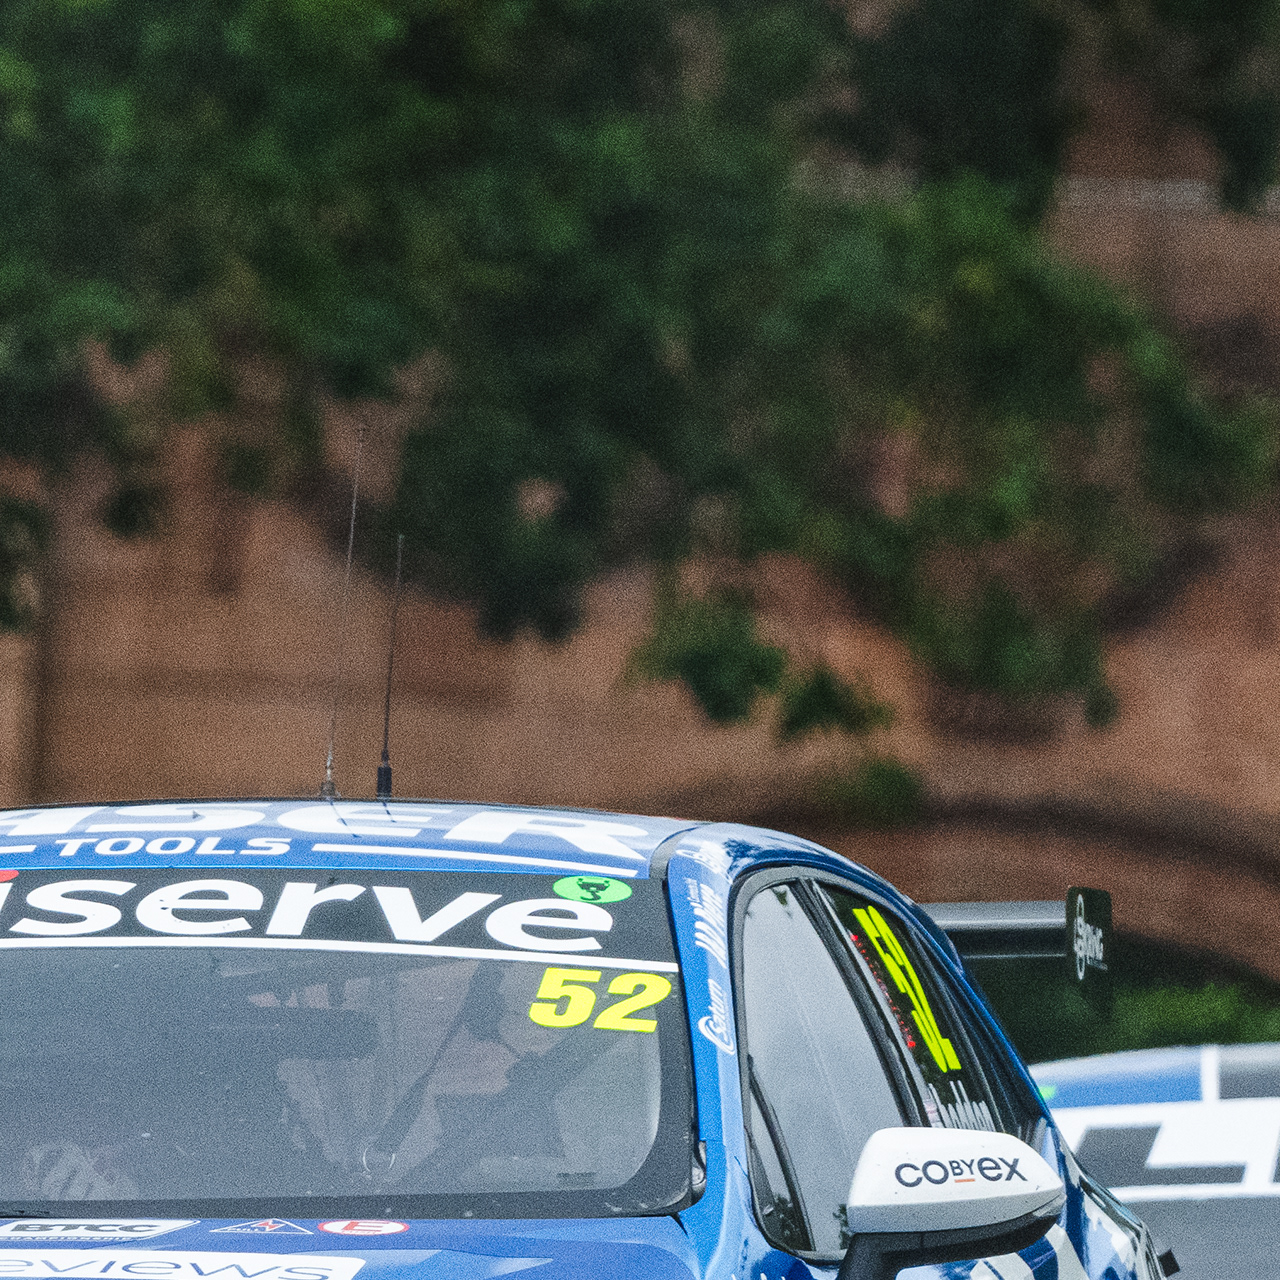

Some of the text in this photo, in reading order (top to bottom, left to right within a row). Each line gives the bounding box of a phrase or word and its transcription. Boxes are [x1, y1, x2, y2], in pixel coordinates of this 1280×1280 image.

[55, 837, 291, 857] TOOLS
[528, 967, 672, 1033] 52
[10, 1223, 158, 1233] BTCC
